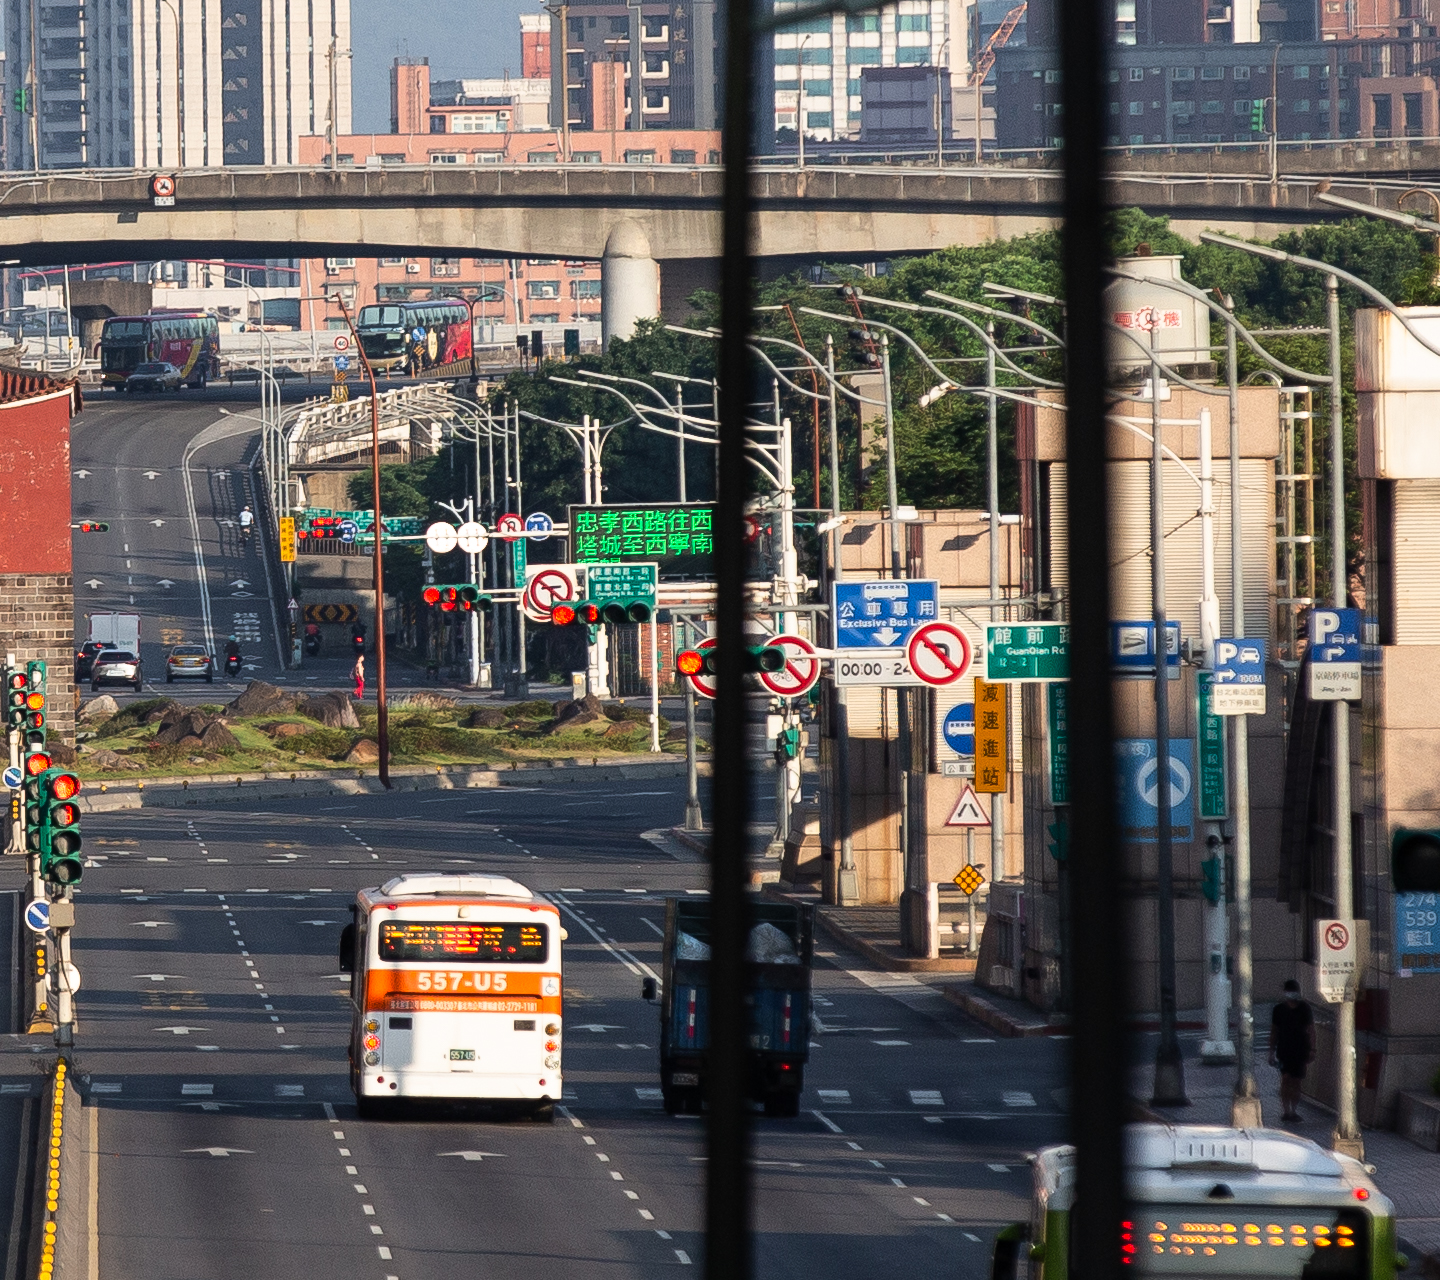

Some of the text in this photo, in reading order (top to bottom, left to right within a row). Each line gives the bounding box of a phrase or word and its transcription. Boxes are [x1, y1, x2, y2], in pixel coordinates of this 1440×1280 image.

[576, 509, 713, 533] 忠孝西路往西
[576, 533, 714, 557] 塔城至西寧南
[839, 601, 934, 617] 公車專用
[840, 618, 908, 628] Exclusive Bus
[1314, 611, 1340, 644] P
[1006, 647, 1049, 657] GuanQian
[1219, 642, 1238, 664] P
[841, 662, 882, 677] 00:00
[982, 683, 1000, 787] 減速進站
[418, 973, 508, 992] 557-U5
[450, 1050, 475, 1060] 557-U5
